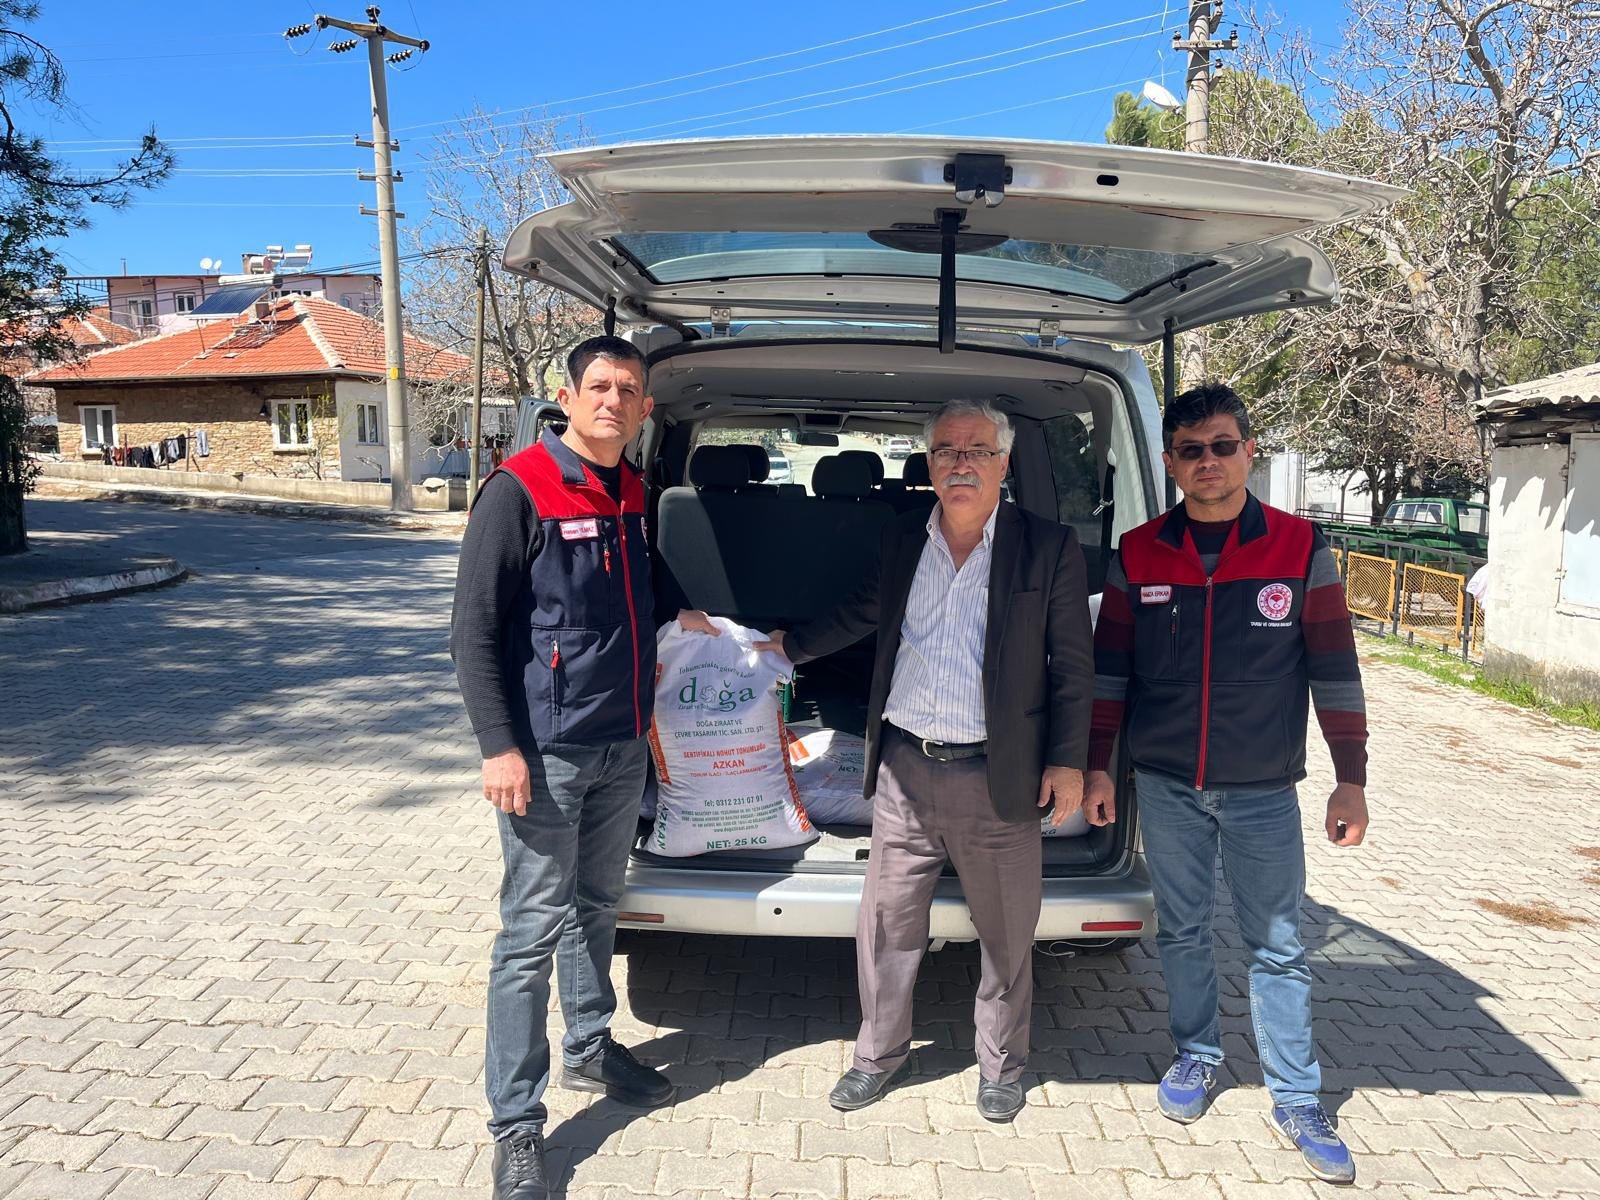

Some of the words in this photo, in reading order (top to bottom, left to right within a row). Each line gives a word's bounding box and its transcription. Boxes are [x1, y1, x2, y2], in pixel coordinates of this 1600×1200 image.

[679, 676, 757, 712] doğa
[696, 719, 713, 727] DOĞA
[674, 731, 692, 739] ÇEVRE
[693, 729, 718, 737] TASARIM
[716, 748, 735, 757] NOHUT
[713, 759, 745, 769] AZKAN
[704, 799, 715, 807] Tel:
[715, 798, 732, 807] 0312
[733, 797, 745, 805] 231
[746, 796, 754, 804] 07
[755, 794, 763, 802] 91
[706, 839, 732, 849] NET:
[734, 838, 748, 847] 25
[750, 836, 768, 845] KG
